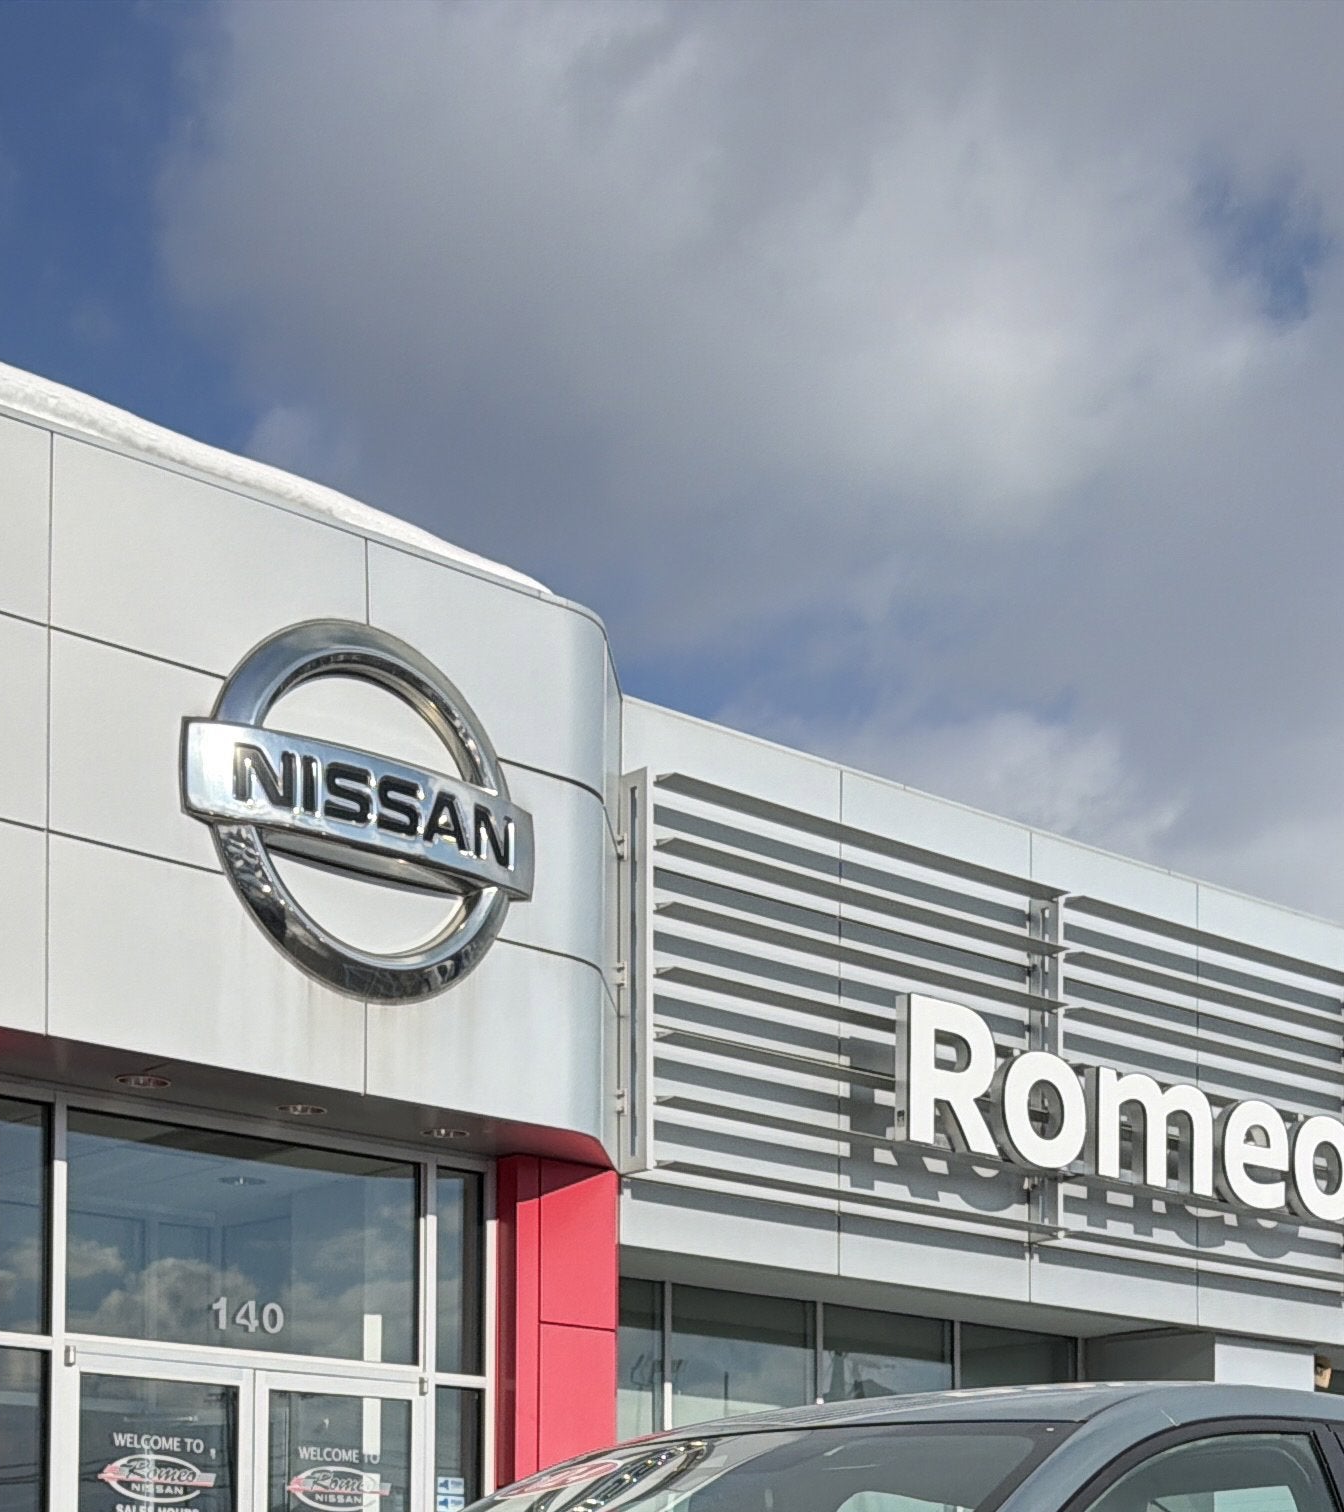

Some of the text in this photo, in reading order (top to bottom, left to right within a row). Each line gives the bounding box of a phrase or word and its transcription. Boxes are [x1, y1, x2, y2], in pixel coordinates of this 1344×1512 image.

[233, 742, 516, 872] NISSAN
[212, 1296, 284, 1334] 140
[113, 1432, 205, 1454] WELCOME TO
[298, 1446, 360, 1464] WELCOME
[120, 1458, 198, 1482] Romeo
[131, 1483, 184, 1495] NISSAN
[315, 1494, 362, 1504] NISSAN
